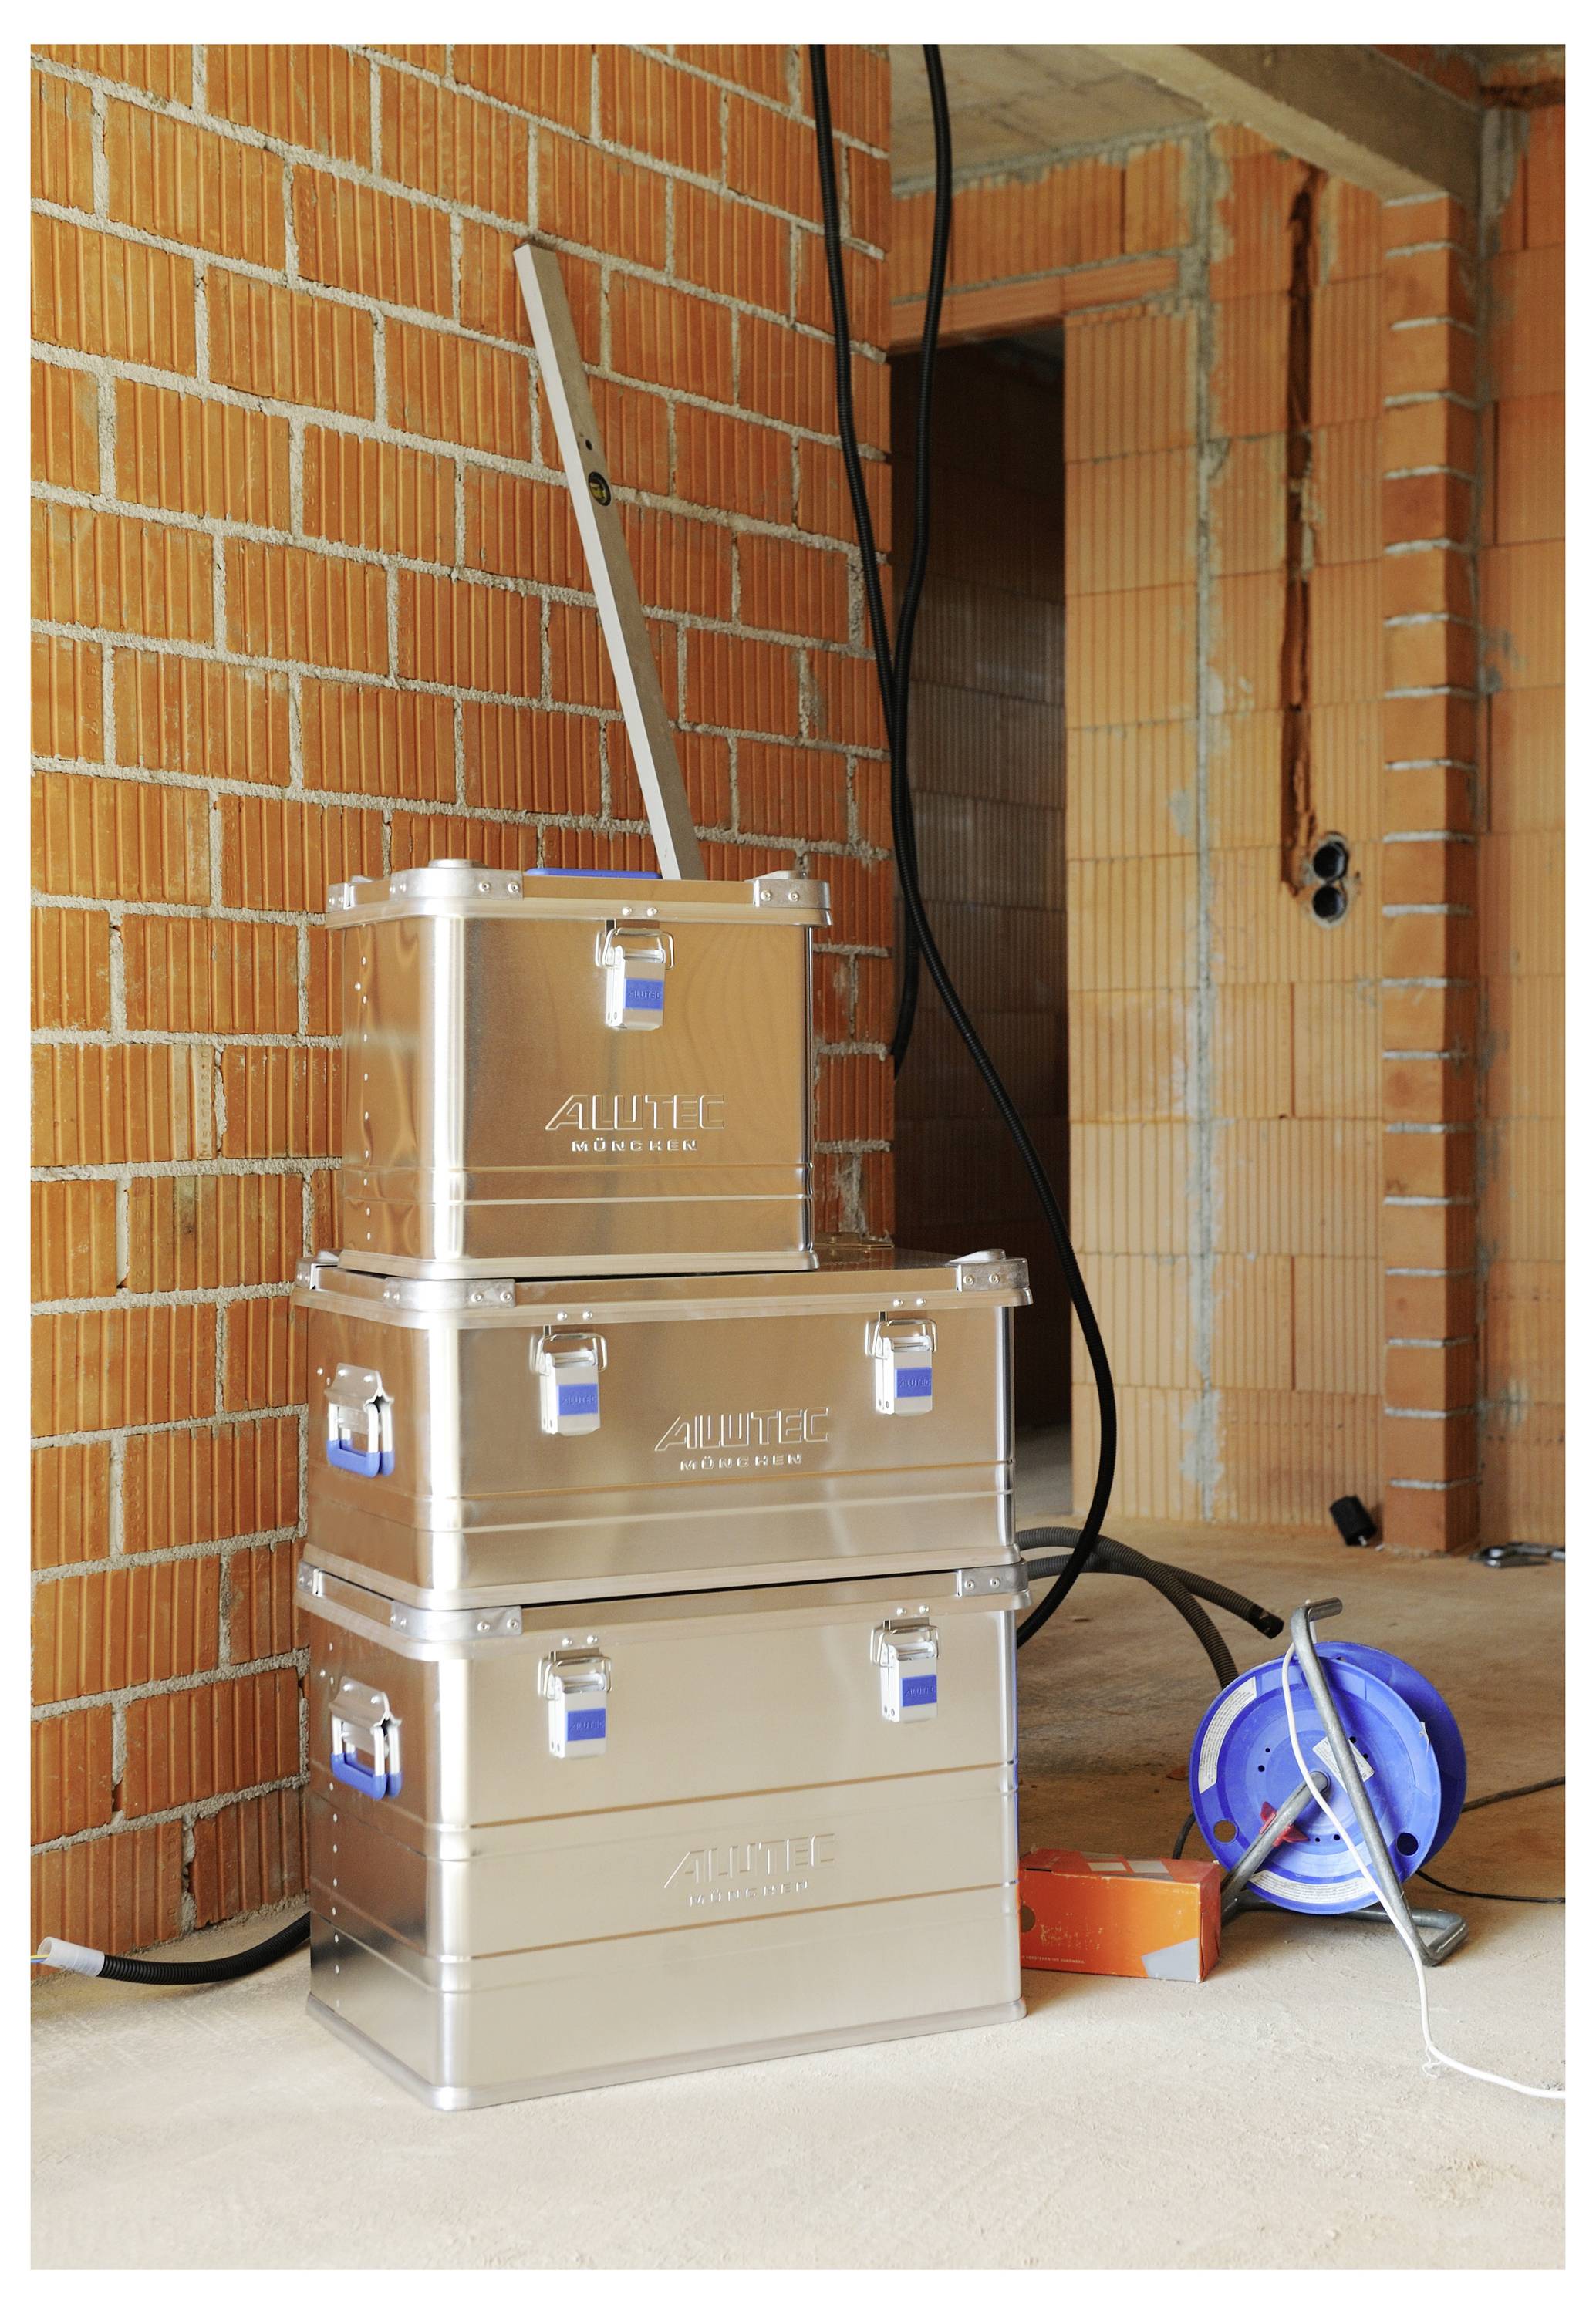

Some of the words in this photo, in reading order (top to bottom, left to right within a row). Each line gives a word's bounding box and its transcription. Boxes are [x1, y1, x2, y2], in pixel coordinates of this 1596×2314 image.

[545, 1094, 725, 1131] ALUTEC
[571, 1138, 698, 1152] MÜNCHEN
[653, 1406, 830, 1452] ALUTEC
[680, 1453, 803, 1471] MÜNCHEN
[663, 1833, 835, 1889] ALUTEC
[689, 1880, 808, 1907] MÜNCHEN
